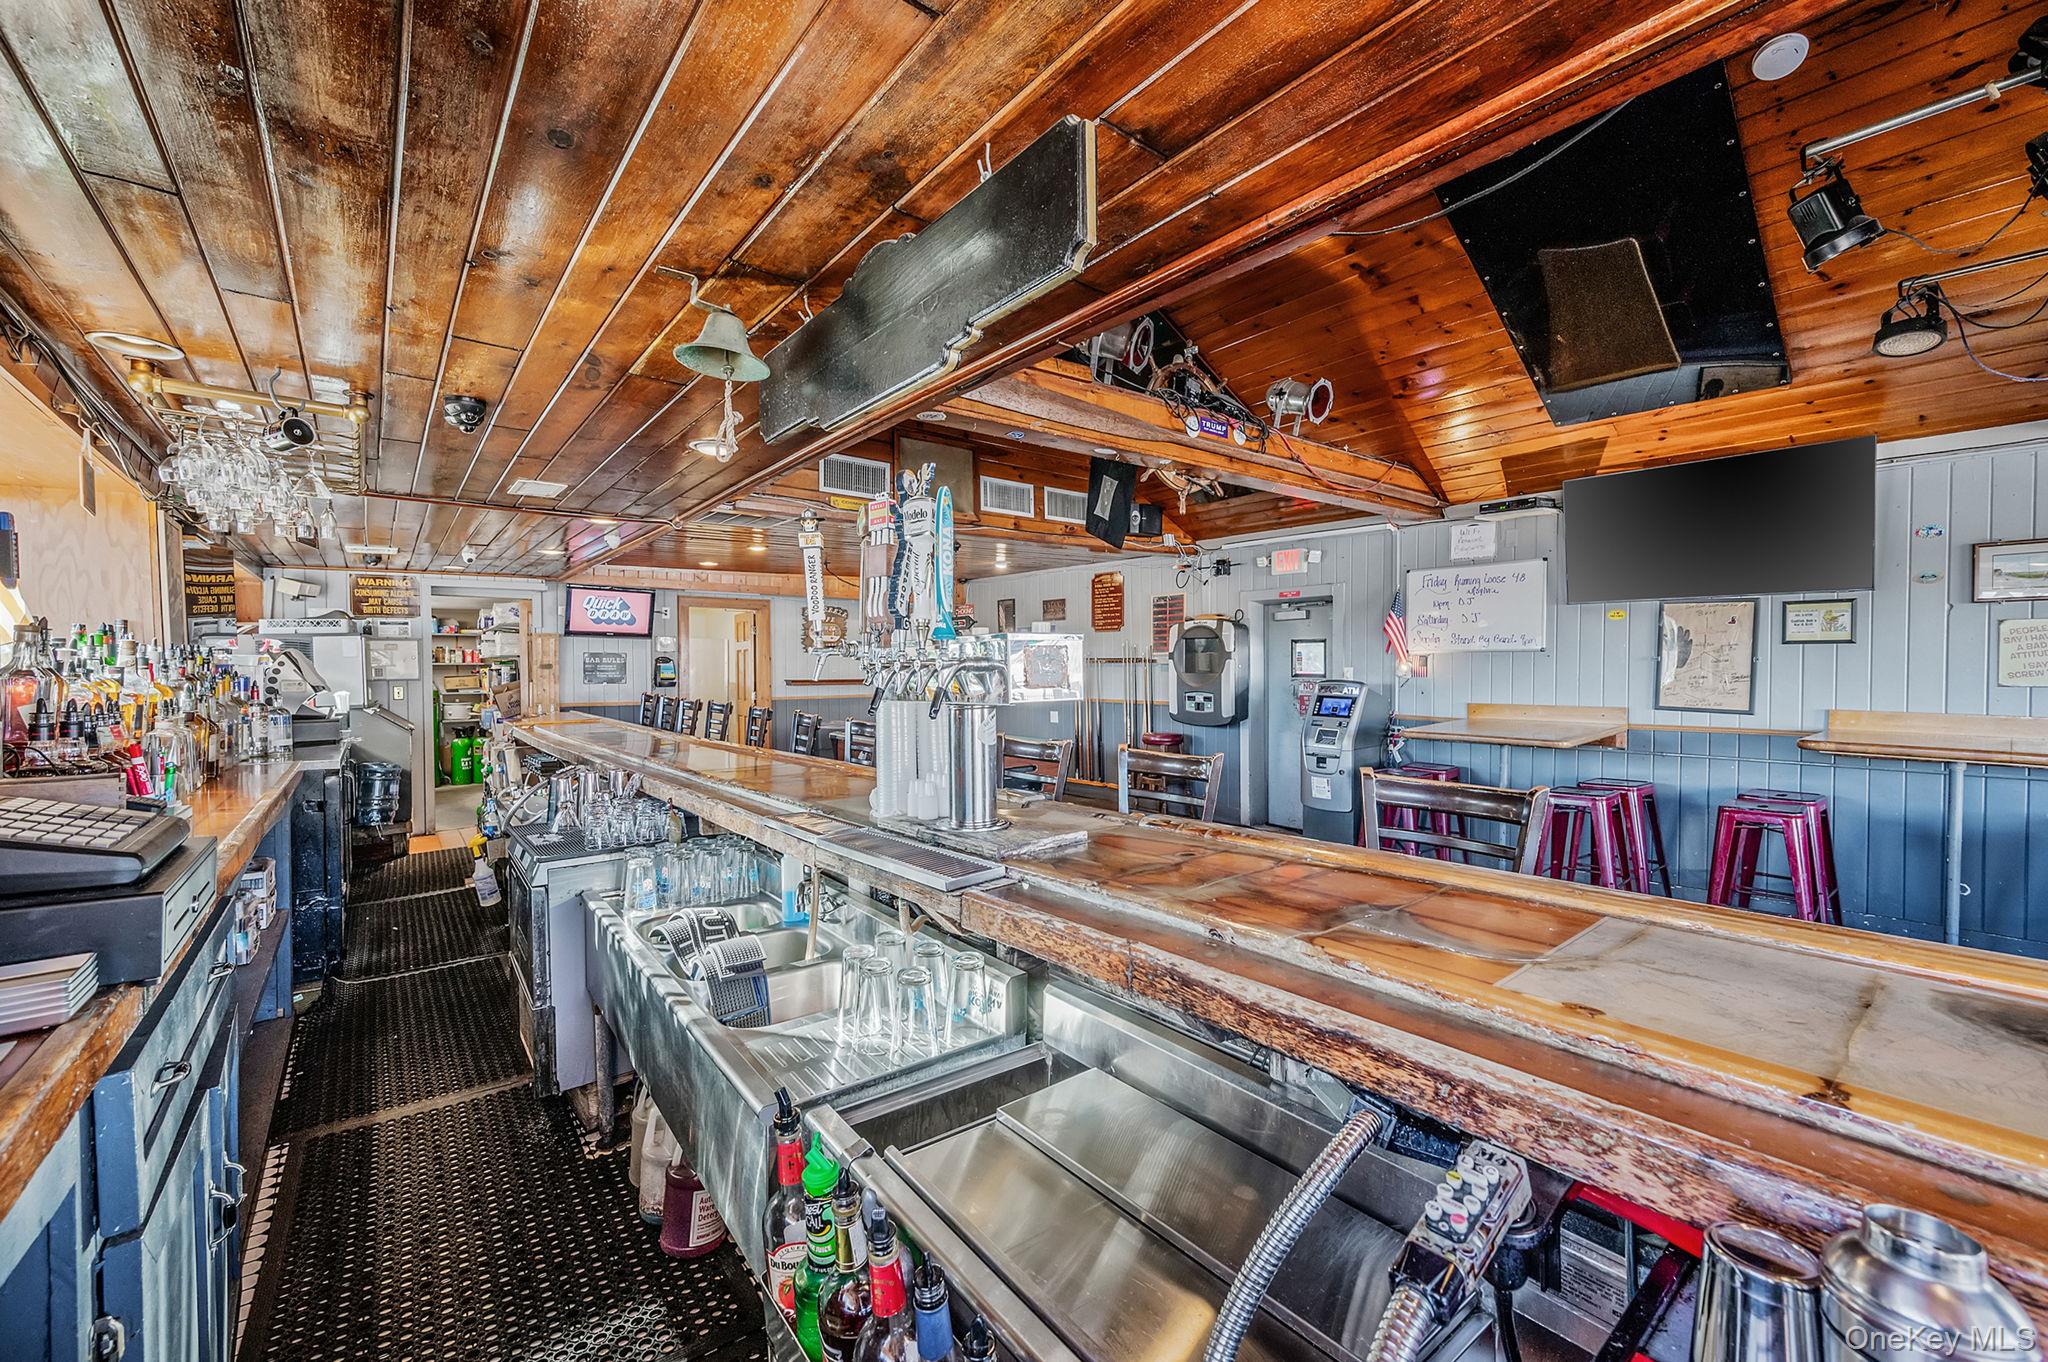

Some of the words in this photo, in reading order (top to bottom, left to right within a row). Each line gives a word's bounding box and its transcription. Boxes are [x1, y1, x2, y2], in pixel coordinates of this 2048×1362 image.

[1202, 420, 1227, 432] TRUMP
[942, 526, 954, 576] KONA
[808, 554, 817, 585] RANGER
[357, 577, 411, 588] WARNING
[1421, 573, 1449, 591] Friday
[354, 588, 389, 597] CONSUMING
[390, 589, 415, 598] ALCOHOL
[368, 597, 381, 606] MAY
[383, 597, 403, 606] CAUSE
[583, 595, 622, 610] Quick
[811, 586, 820, 615] VOODOO
[362, 606, 381, 614] BIRTH
[382, 606, 409, 615] DEFECTS
[589, 610, 629, 619] DRAW
[2009, 624, 2048, 635] PEOPLE
[2003, 635, 2022, 644] SAY
[2030, 632, 2048, 642] HAV
[2017, 643, 2023, 651] A
[2026, 641, 2048, 650] BAD
[2010, 650, 2048, 660] ATTITUD
[2028, 661, 2048, 669] SAY
[2008, 670, 2045, 679] SCREW
[1303, 682, 1316, 691] NO
[1342, 686, 1360, 695] ATM
[698, 1211, 719, 1222] Deterg
[806, 1215, 824, 1230] CALL
